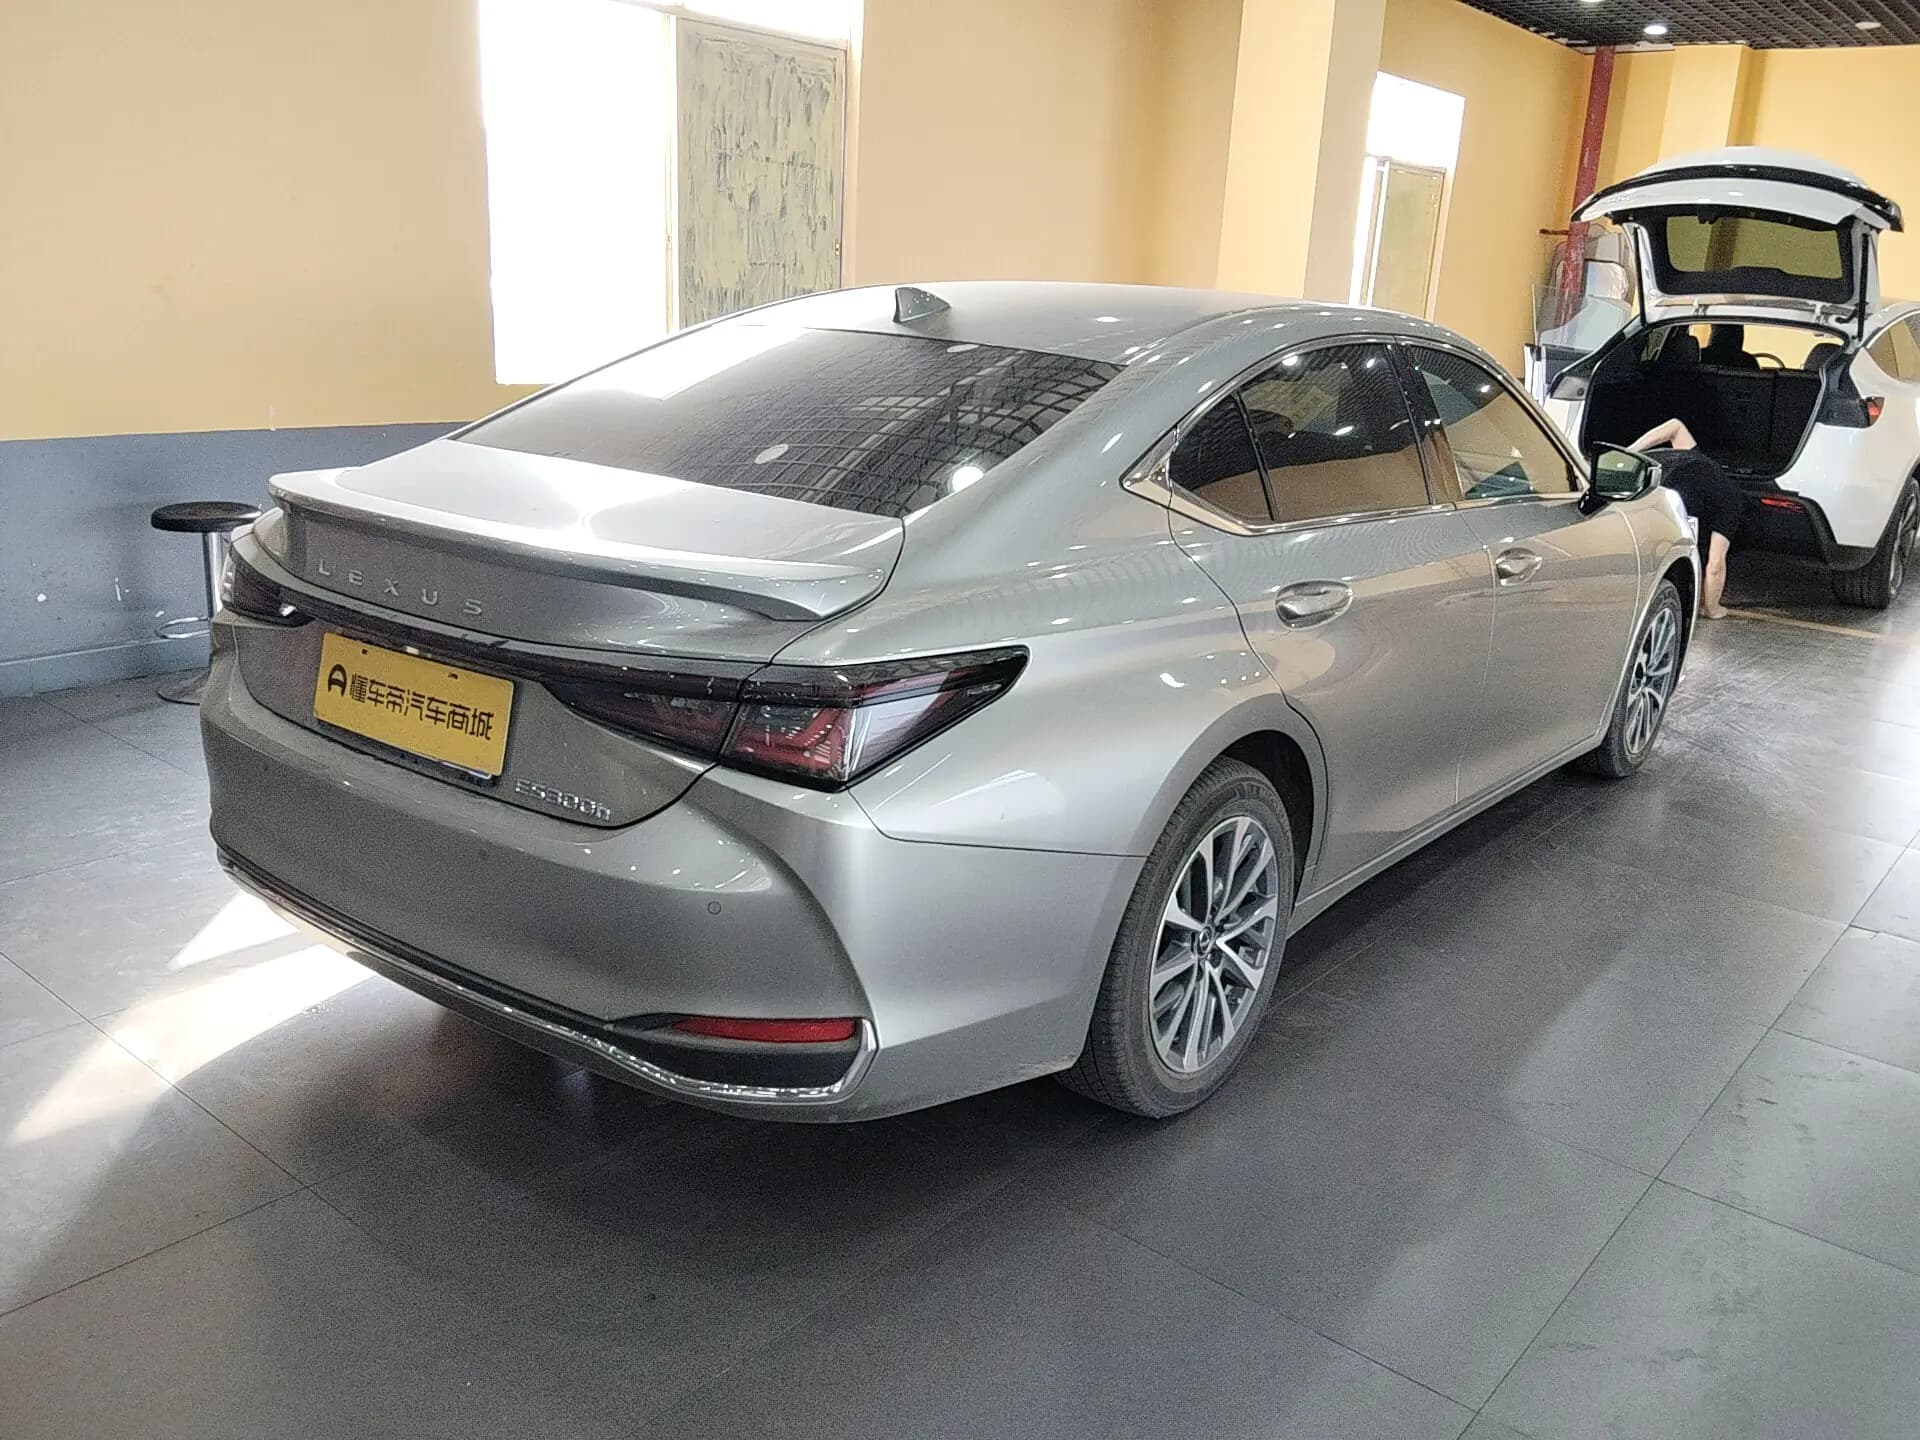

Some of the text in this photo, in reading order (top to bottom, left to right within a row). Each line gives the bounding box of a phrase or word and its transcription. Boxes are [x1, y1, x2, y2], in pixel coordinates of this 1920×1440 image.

[318, 559, 482, 616] LEXUS
[350, 672, 495, 741] 懂车帝汽车商城
